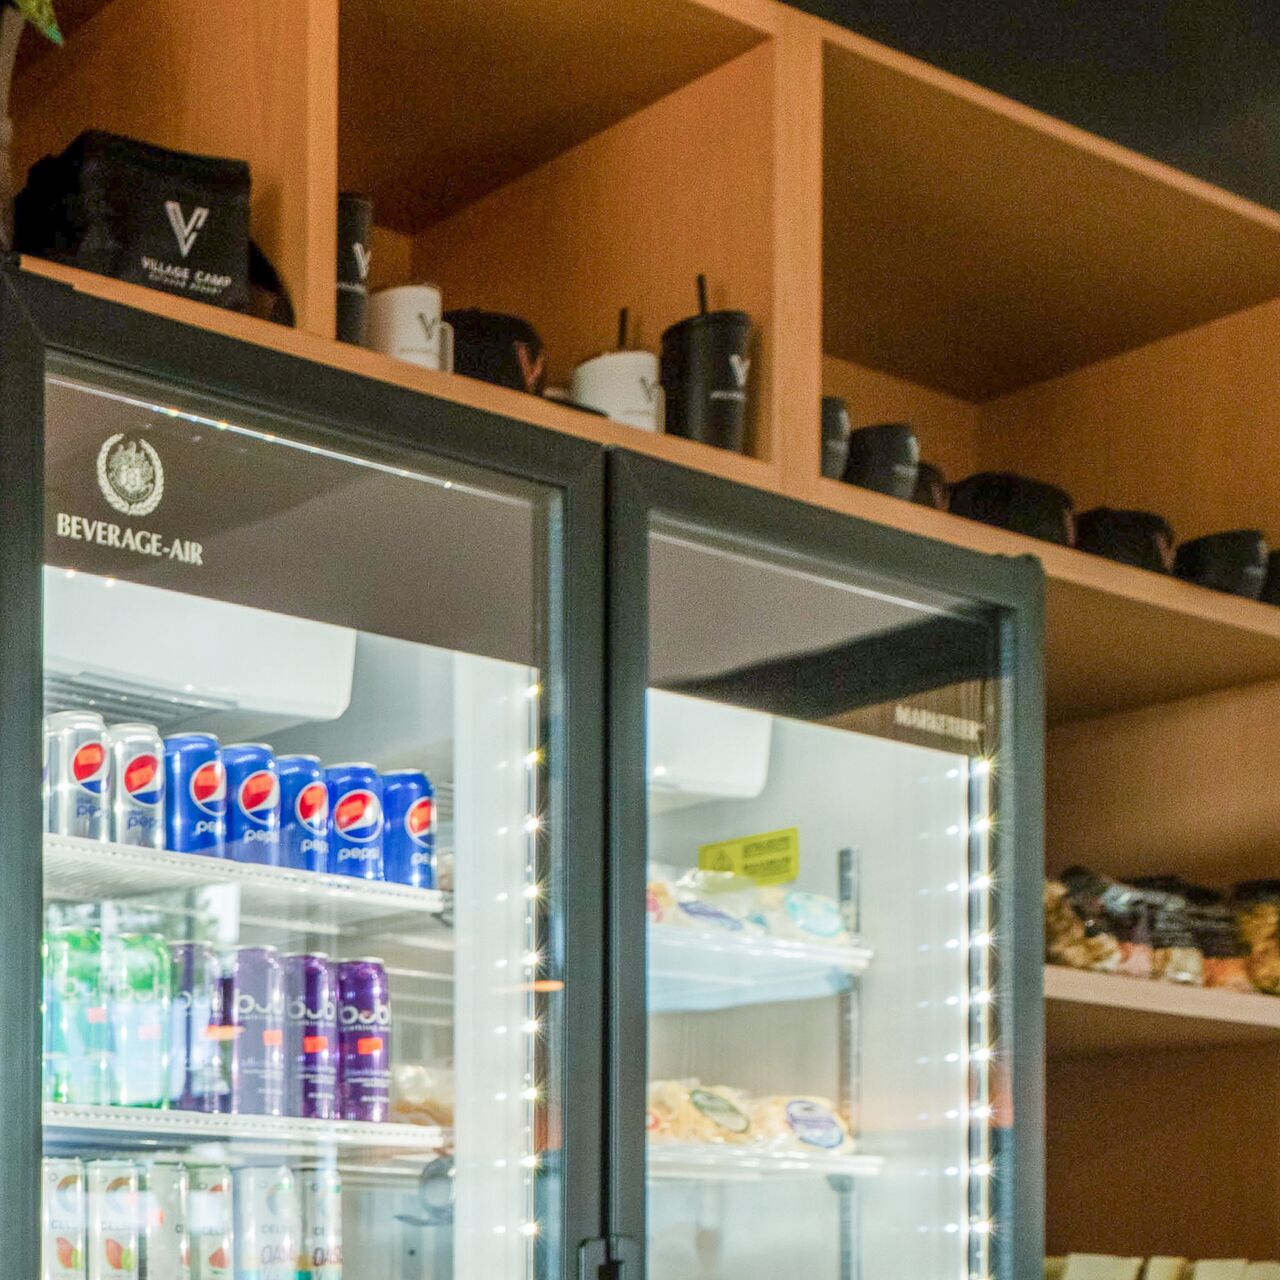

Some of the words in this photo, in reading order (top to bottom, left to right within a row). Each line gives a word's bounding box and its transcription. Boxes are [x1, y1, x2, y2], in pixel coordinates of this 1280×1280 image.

[142, 256, 191, 278] VILLAGE
[197, 271, 232, 289] CAMP
[56, 513, 203, 565] BEVERAGE-AIR
[338, 846, 380, 863] pepsi
